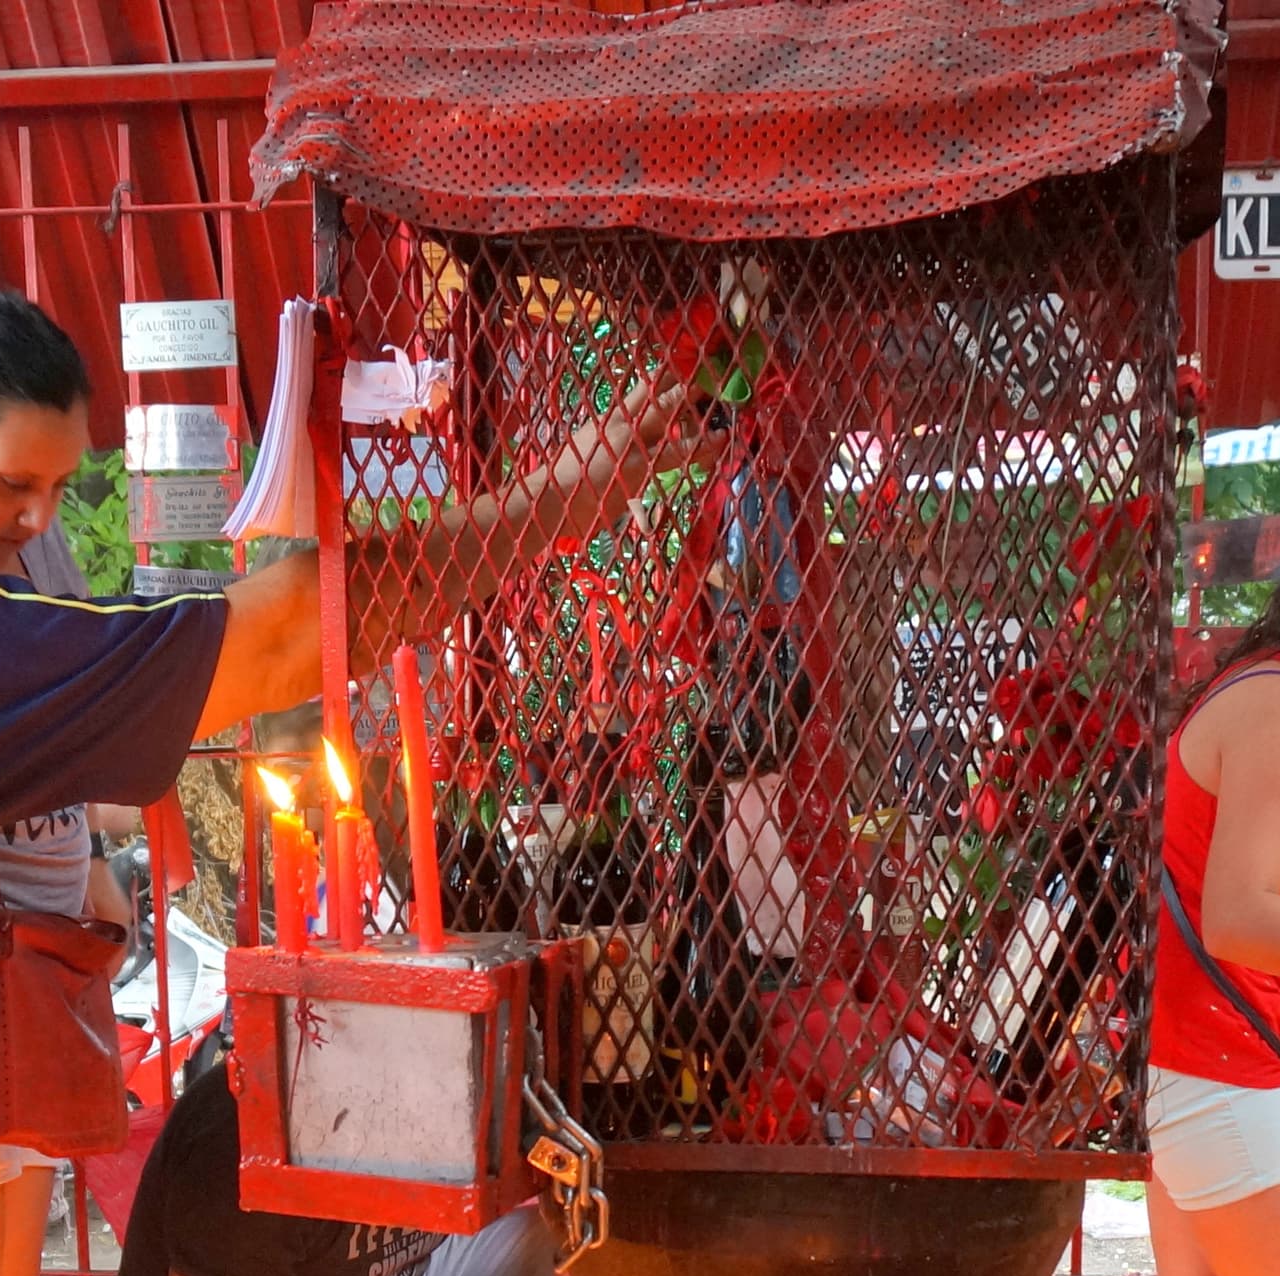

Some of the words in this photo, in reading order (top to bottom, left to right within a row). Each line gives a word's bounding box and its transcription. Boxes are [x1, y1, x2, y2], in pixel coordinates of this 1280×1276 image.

[136, 319, 197, 332] GAUCHITO
[200, 318, 219, 331] GIL
[183, 352, 218, 361] JIMENEZ
